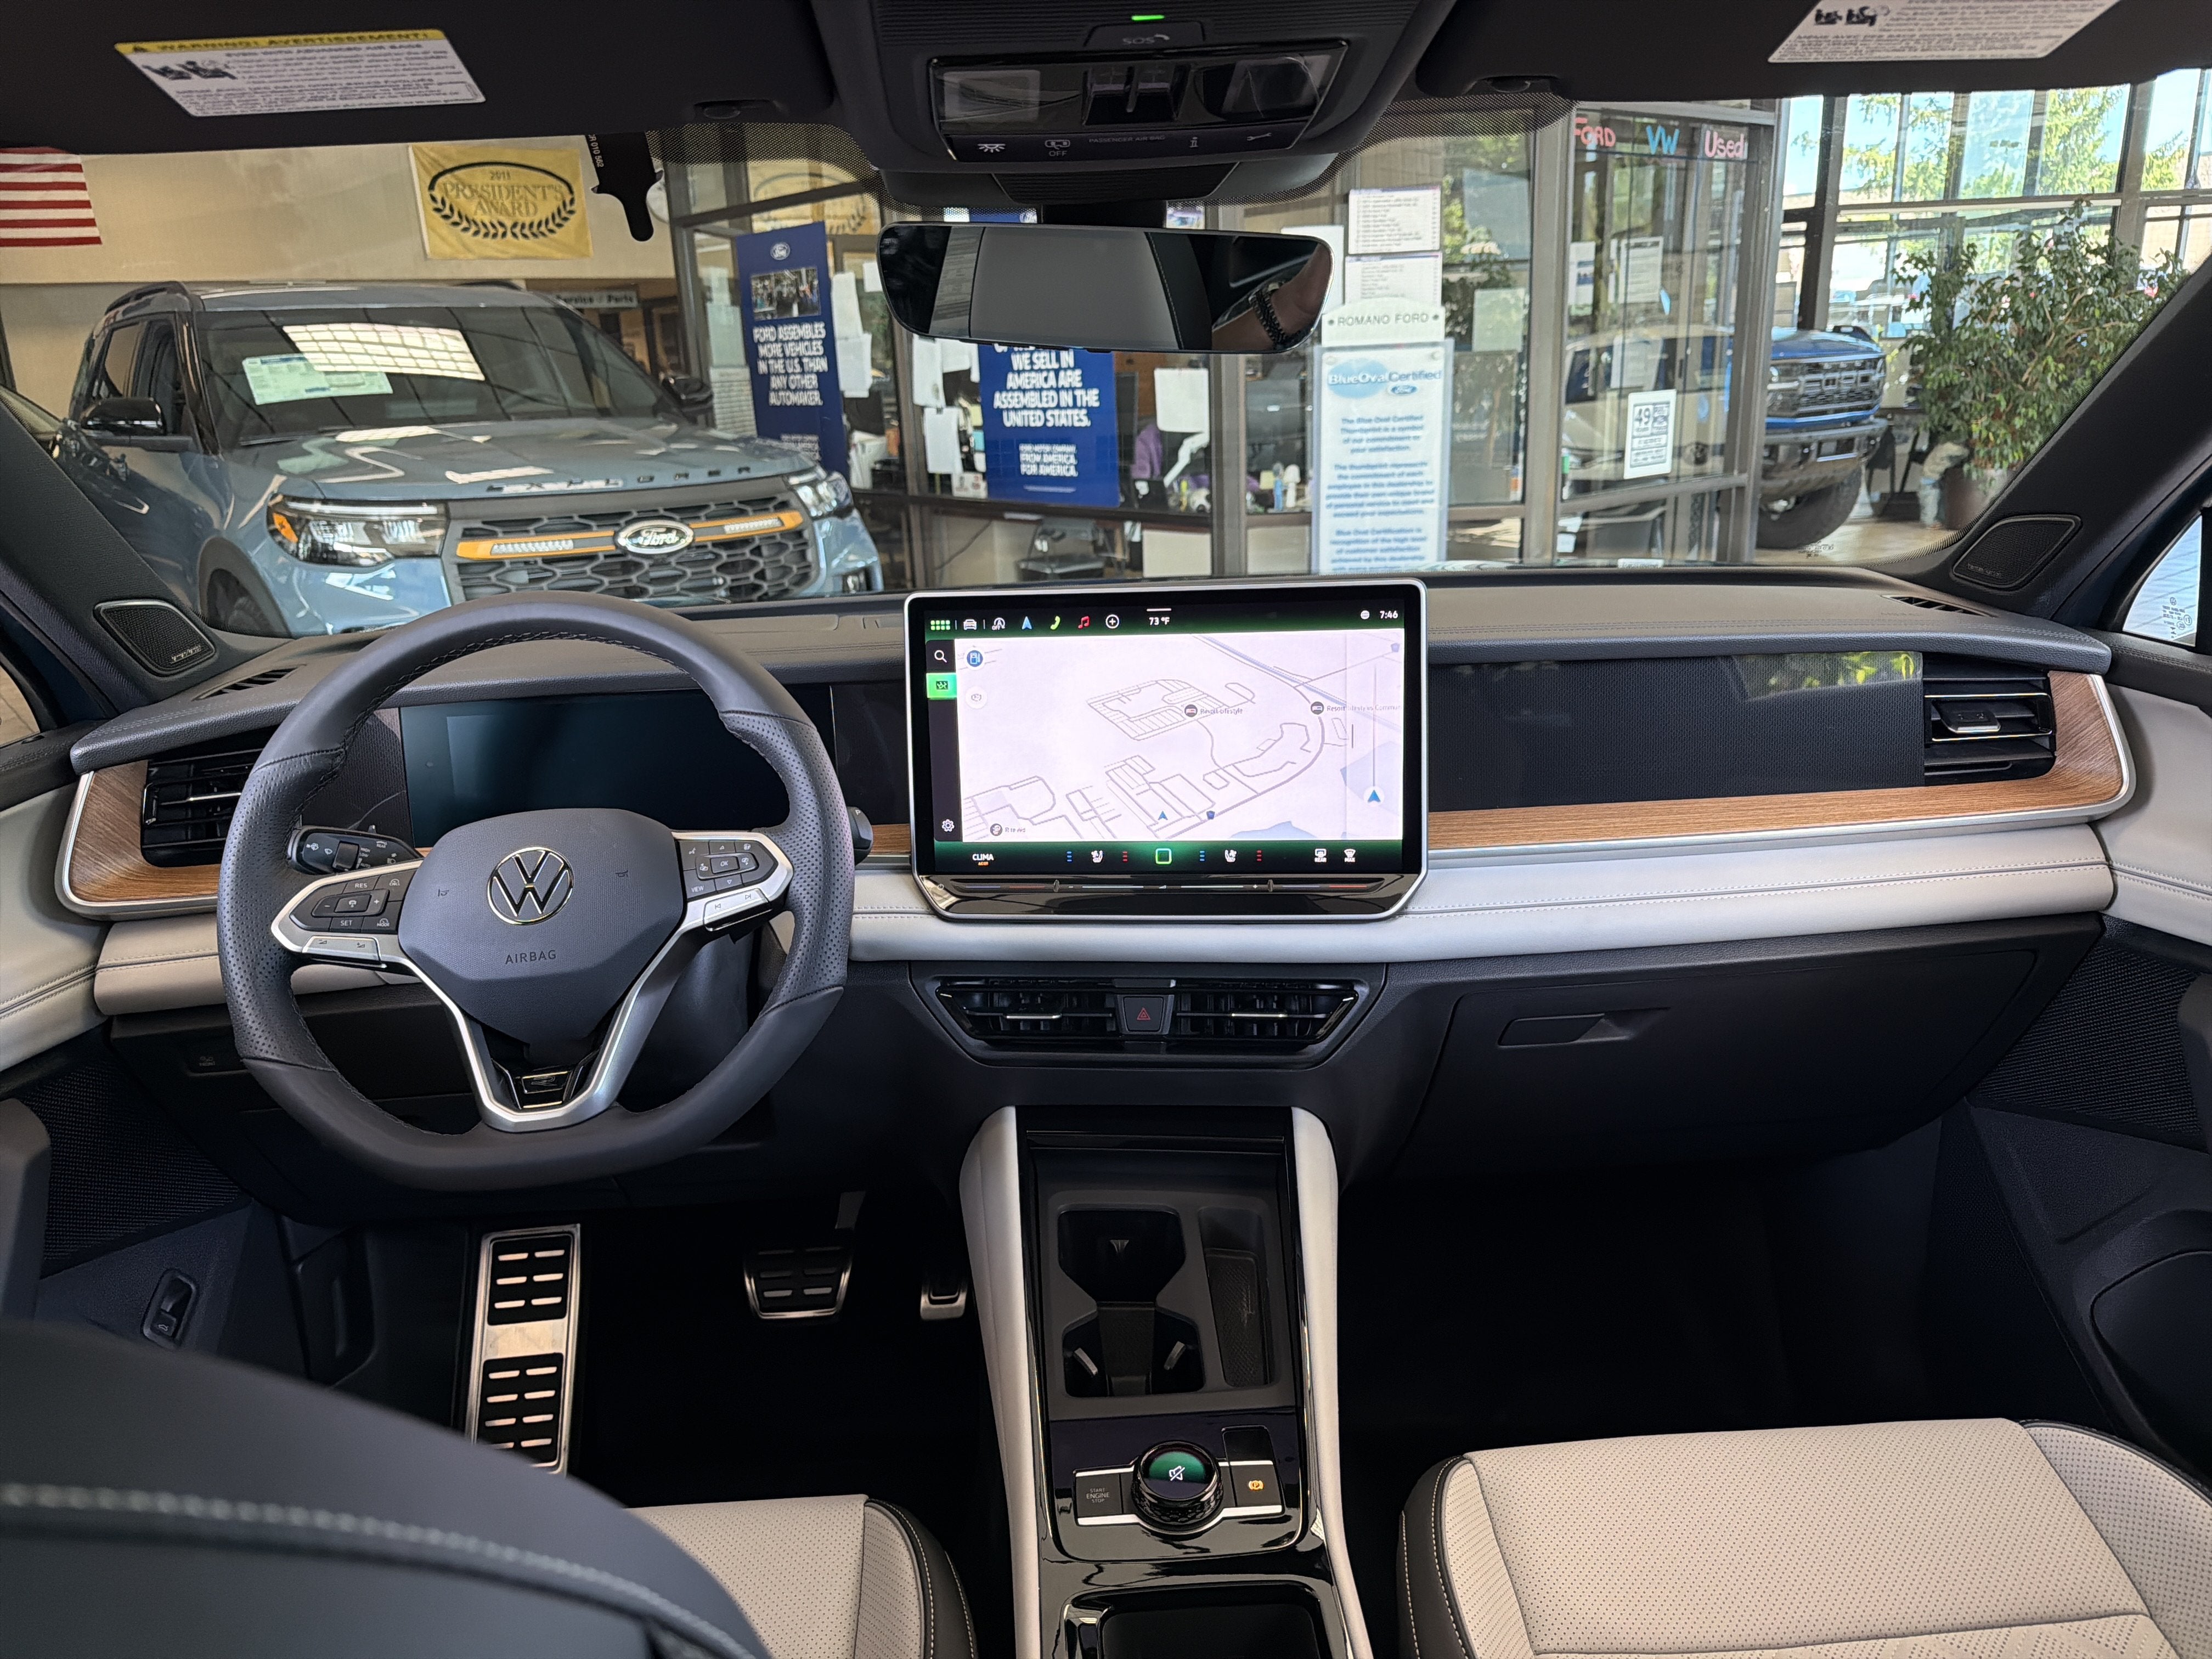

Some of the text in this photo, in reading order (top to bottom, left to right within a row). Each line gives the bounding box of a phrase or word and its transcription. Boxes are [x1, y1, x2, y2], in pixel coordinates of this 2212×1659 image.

[591, 142, 601, 155] 010
[1646, 124, 1680, 155] VW
[1705, 129, 1745, 158] Used
[595, 155, 604, 167] 562
[443, 181, 565, 201] PRESIDENT'S
[473, 196, 538, 217] AWARD
[1337, 313, 1429, 326] ROMANO FORD
[753, 321, 826, 343] FORD ASSEMBLES
[758, 340, 824, 358] MORE VEHICLES
[757, 359, 768, 375] IN
[768, 358, 786, 374] THE
[802, 356, 828, 372] THAN
[1011, 348, 1075, 370] WE SELL IN
[770, 373, 818, 390] ANY OTHER
[1006, 369, 1082, 390] AMERICA ARE
[994, 388, 1100, 409] ASSEMBLED IN THE
[1002, 408, 1091, 427] UNITED STATES.
[1635, 408, 1650, 425] 49
[1379, 610, 1398, 619] 7:46
[972, 853, 994, 861] CLIMA
[505, 950, 557, 965] AIRBAG
